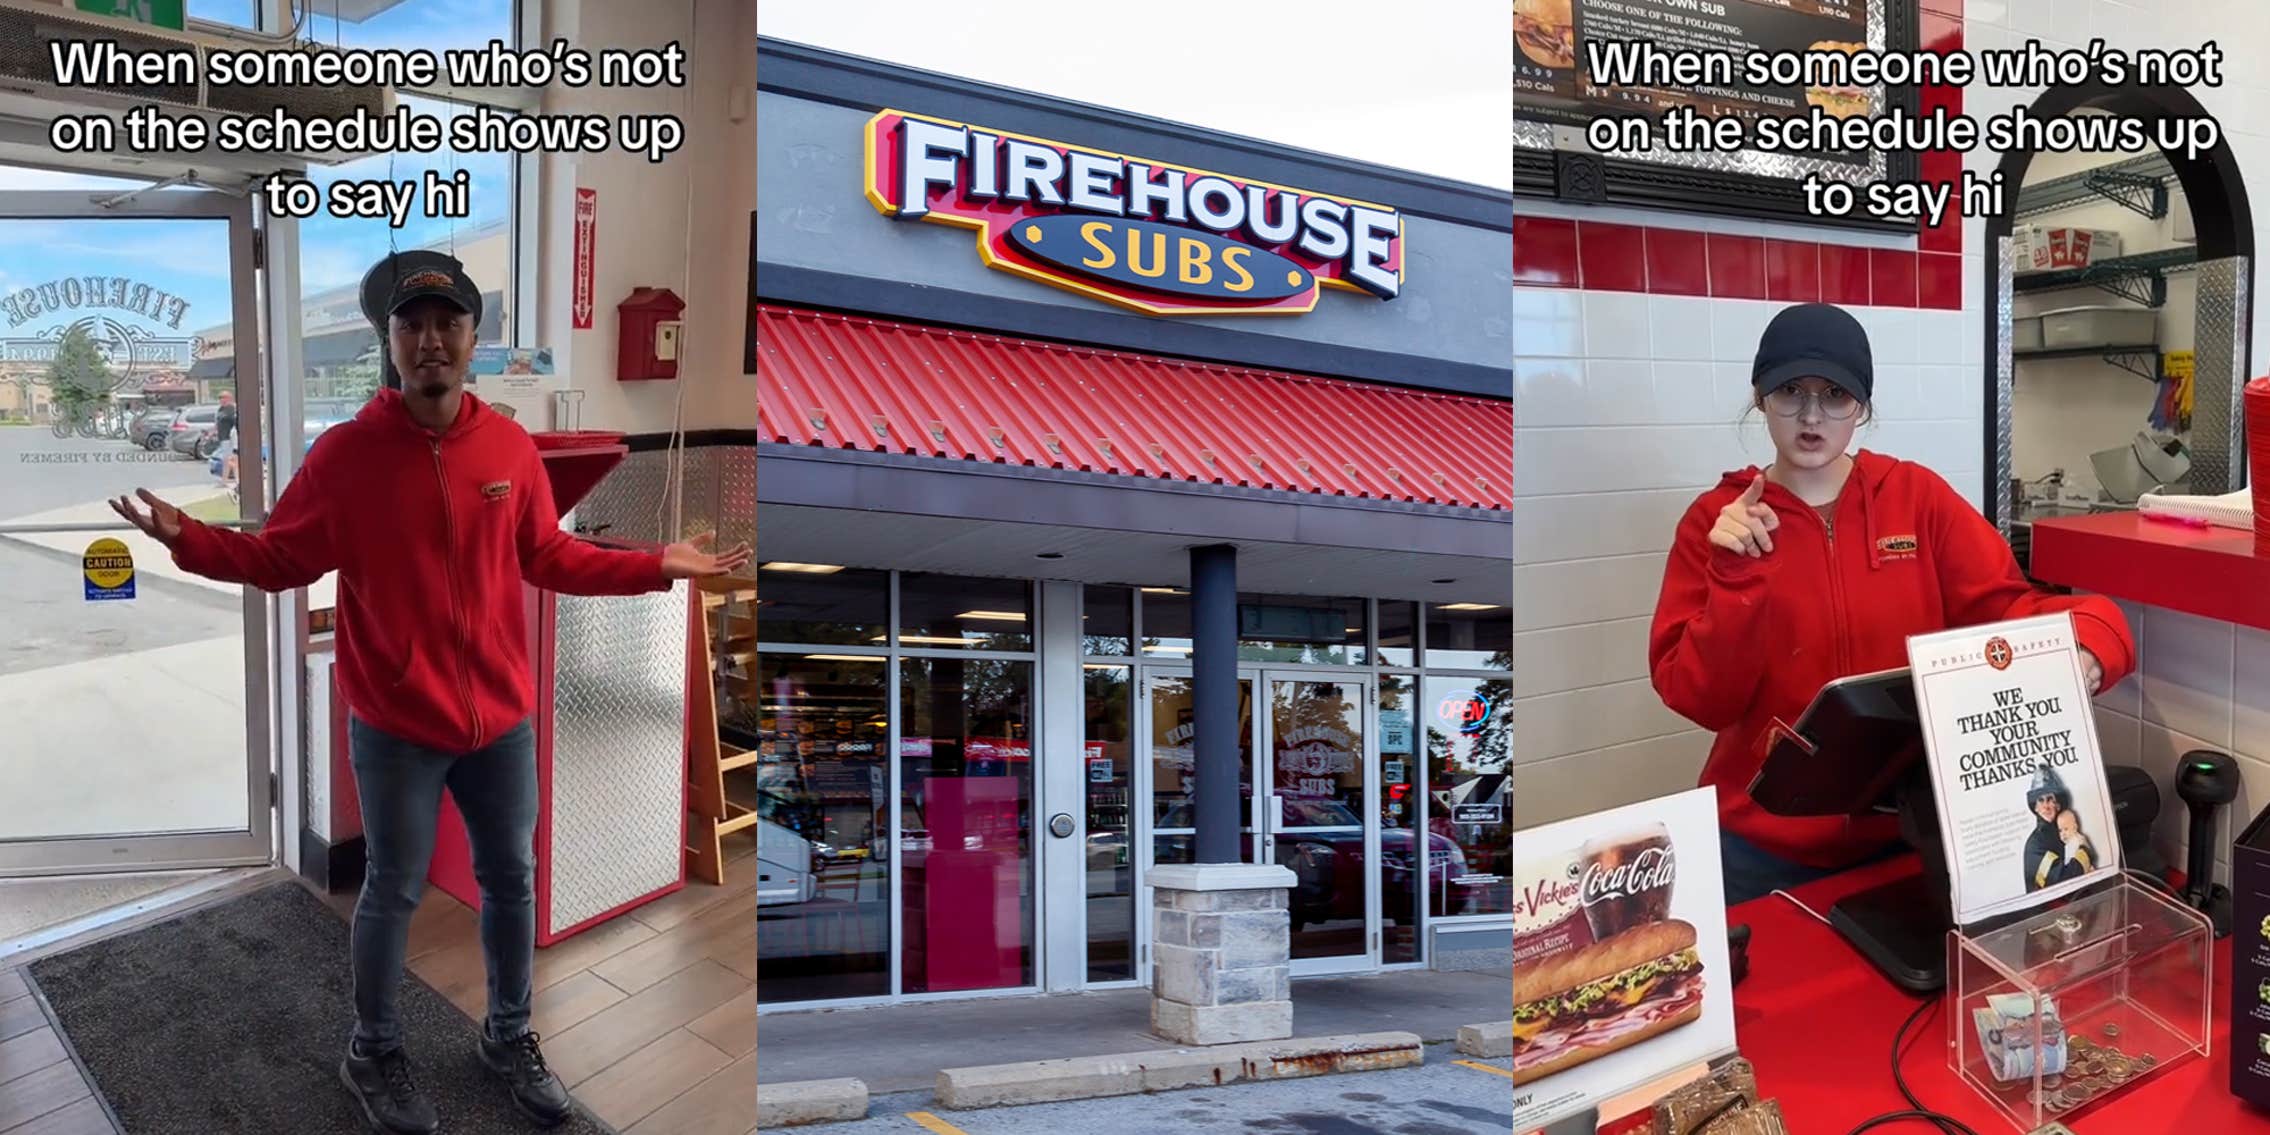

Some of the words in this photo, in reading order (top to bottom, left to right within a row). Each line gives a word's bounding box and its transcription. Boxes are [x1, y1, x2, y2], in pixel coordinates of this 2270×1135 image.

[1583, 0, 1624, 14] CHOOSE
[1625, 6, 1647, 18] ONE
[1648, 11, 1662, 22] OF
[1663, 13, 1684, 25] THE
[1684, 17, 1743, 36] FOLLOWING:
[1664, 0, 1697, 11] OWN
[1701, 3, 1726, 17] SUB
[1835, 8, 1850, 19] Cals
[1534, 82, 1555, 93] Cals
[1586, 86, 1597, 97] M
[1695, 86, 1739, 99] TOPPINGS
[1741, 93, 1761, 102] AND
[1761, 94, 1796, 107] CHEESE
[579, 201, 593, 216] FIRE
[897, 116, 1401, 298] FIREHOUSE
[1080, 221, 1255, 293] SUBS
[86, 558, 131, 568] CAUTION
[1931, 651, 1983, 667] PUBLIC
[2014, 637, 2062, 653] SAFETY
[1993, 687, 2024, 708] WE
[1439, 700, 1485, 721] OPEN
[1957, 705, 2023, 735] THANK
[1989, 720, 2040, 746] YOUR
[1959, 730, 2072, 773] COMMUNITY
[1960, 759, 2038, 792] THANKS
[1299, 779, 1336, 796] SUBS
